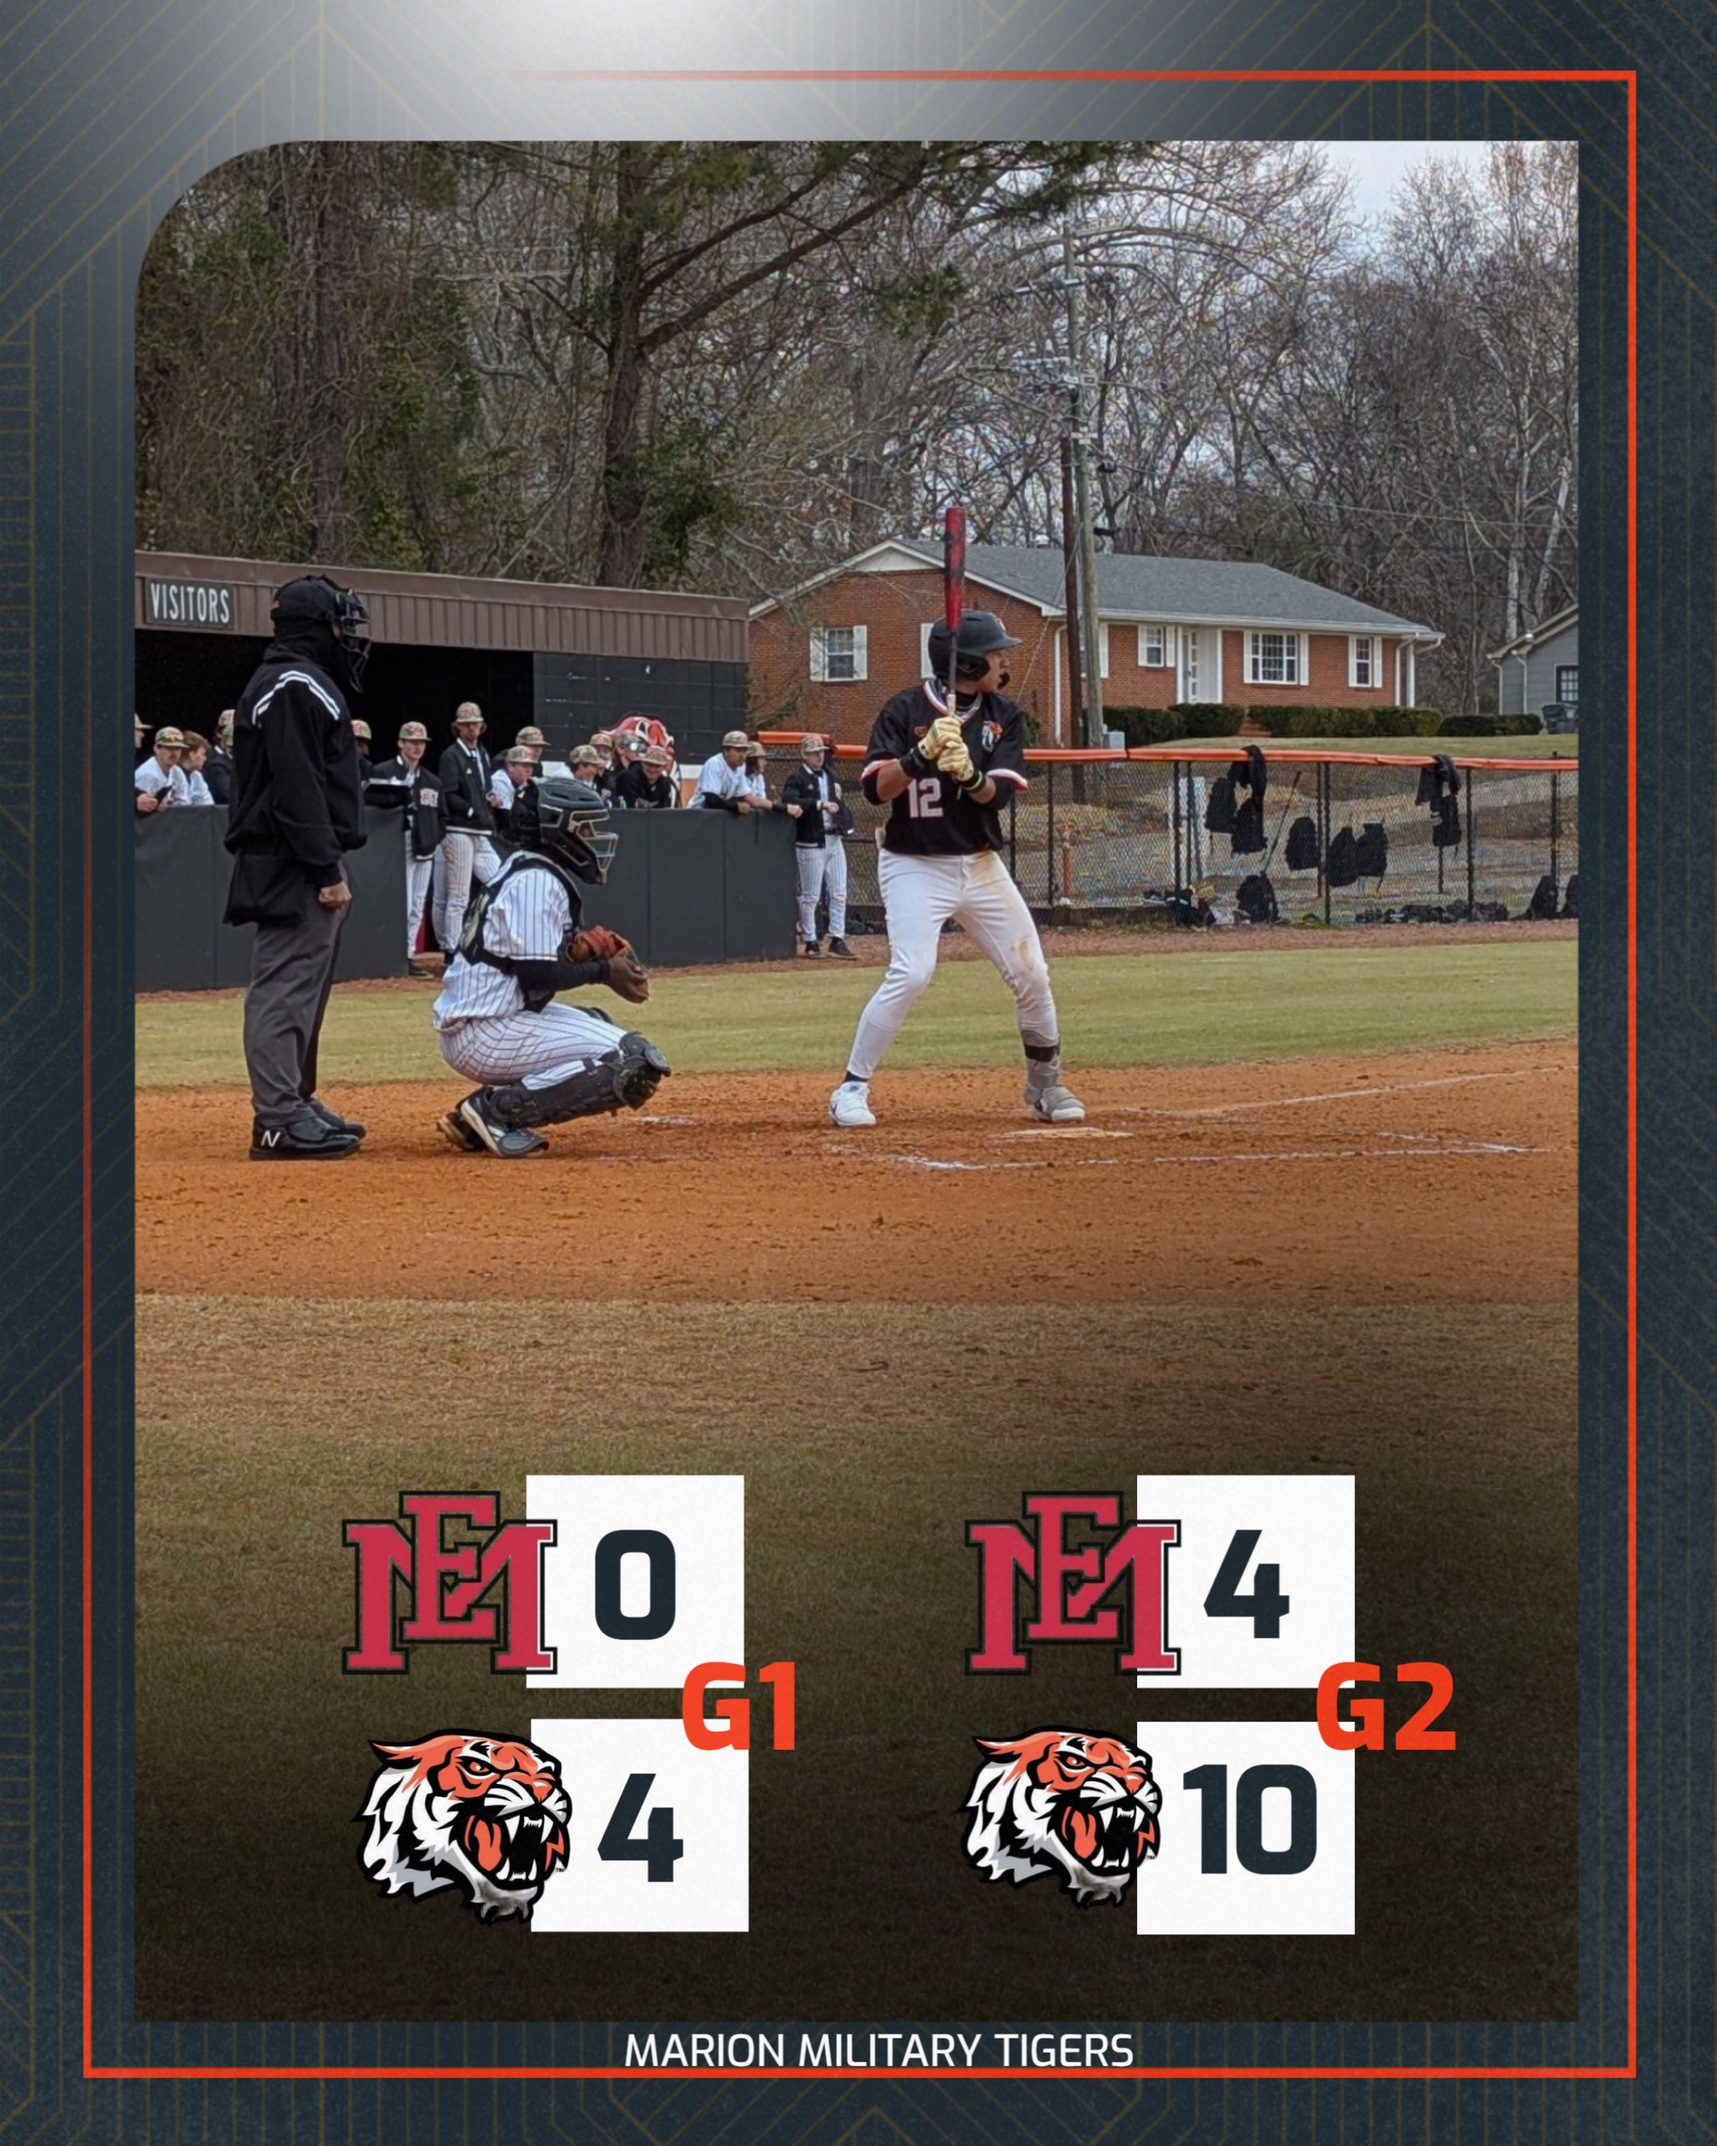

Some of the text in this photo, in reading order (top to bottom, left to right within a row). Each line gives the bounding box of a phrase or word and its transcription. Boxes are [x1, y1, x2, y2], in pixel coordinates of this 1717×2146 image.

[150, 583, 230, 624] VISITORS
[907, 777, 944, 818] 12
[260, 1130, 281, 1148] N
